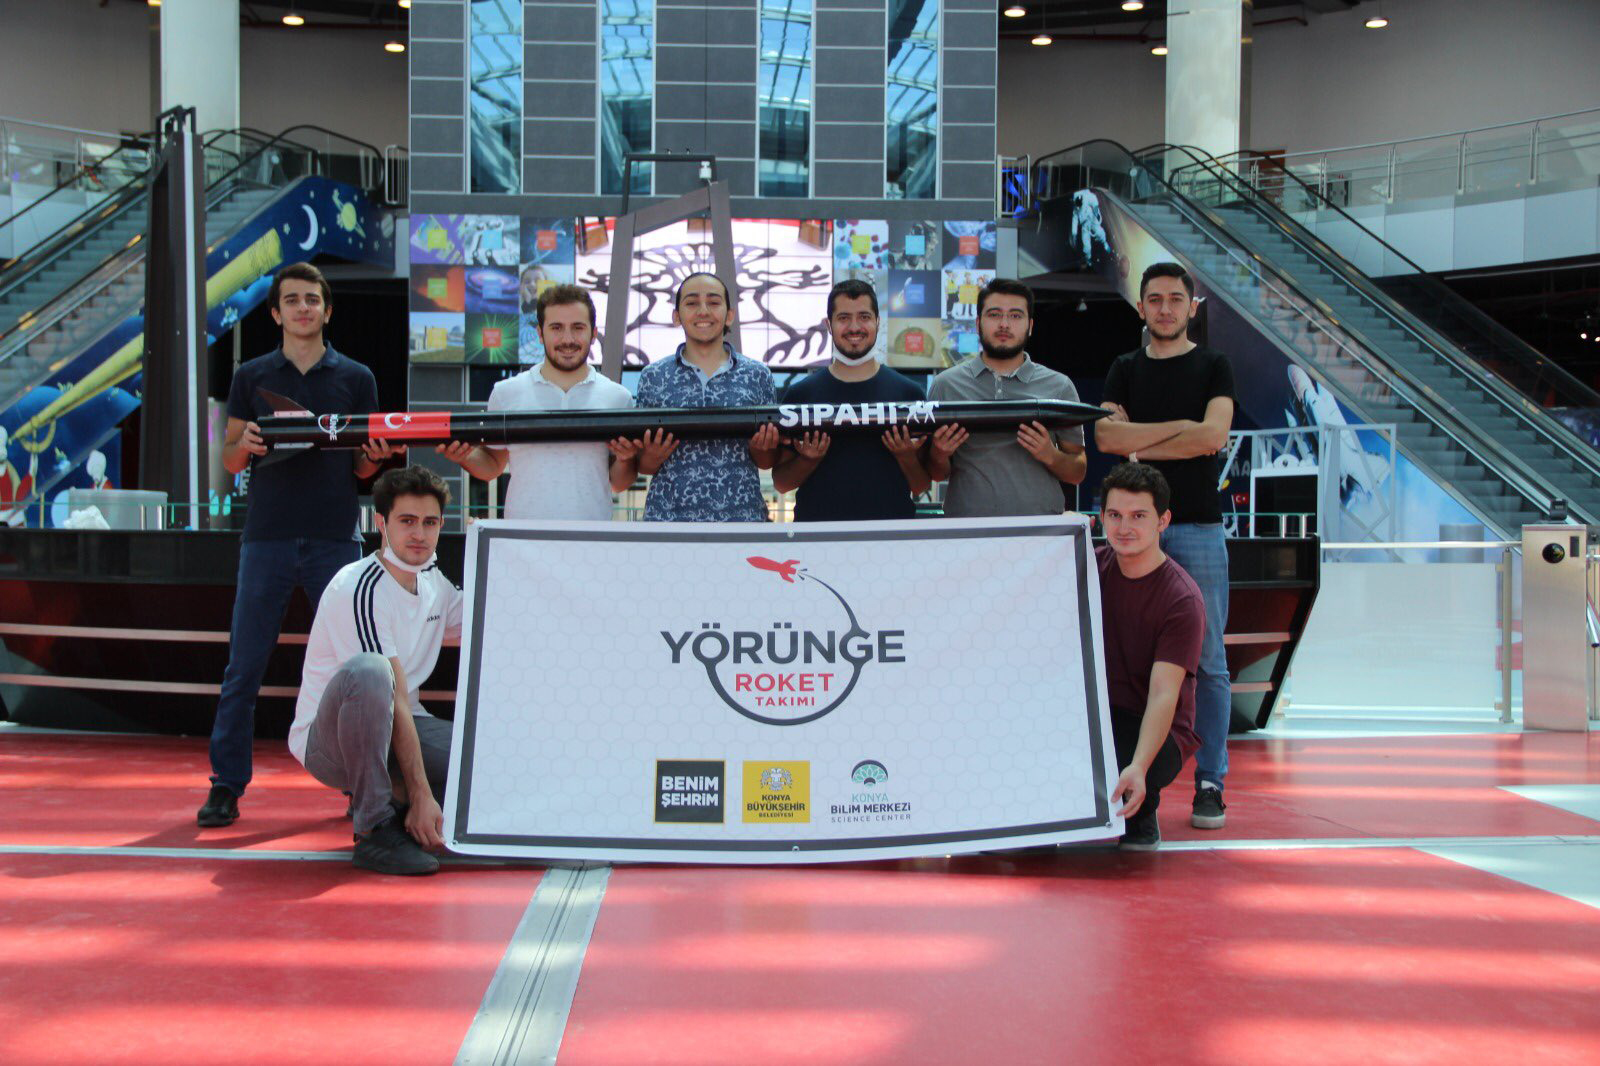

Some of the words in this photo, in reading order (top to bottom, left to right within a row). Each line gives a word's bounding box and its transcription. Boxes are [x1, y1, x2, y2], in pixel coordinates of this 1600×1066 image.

[660, 622, 906, 664] YÖRÜNGE
[735, 673, 834, 692] ROKET
[755, 696, 815, 706] TAKIMI
[851, 793, 889, 803] KONYA
[831, 815, 871, 823] SCIENCE
[875, 813, 911, 822] CENTER
